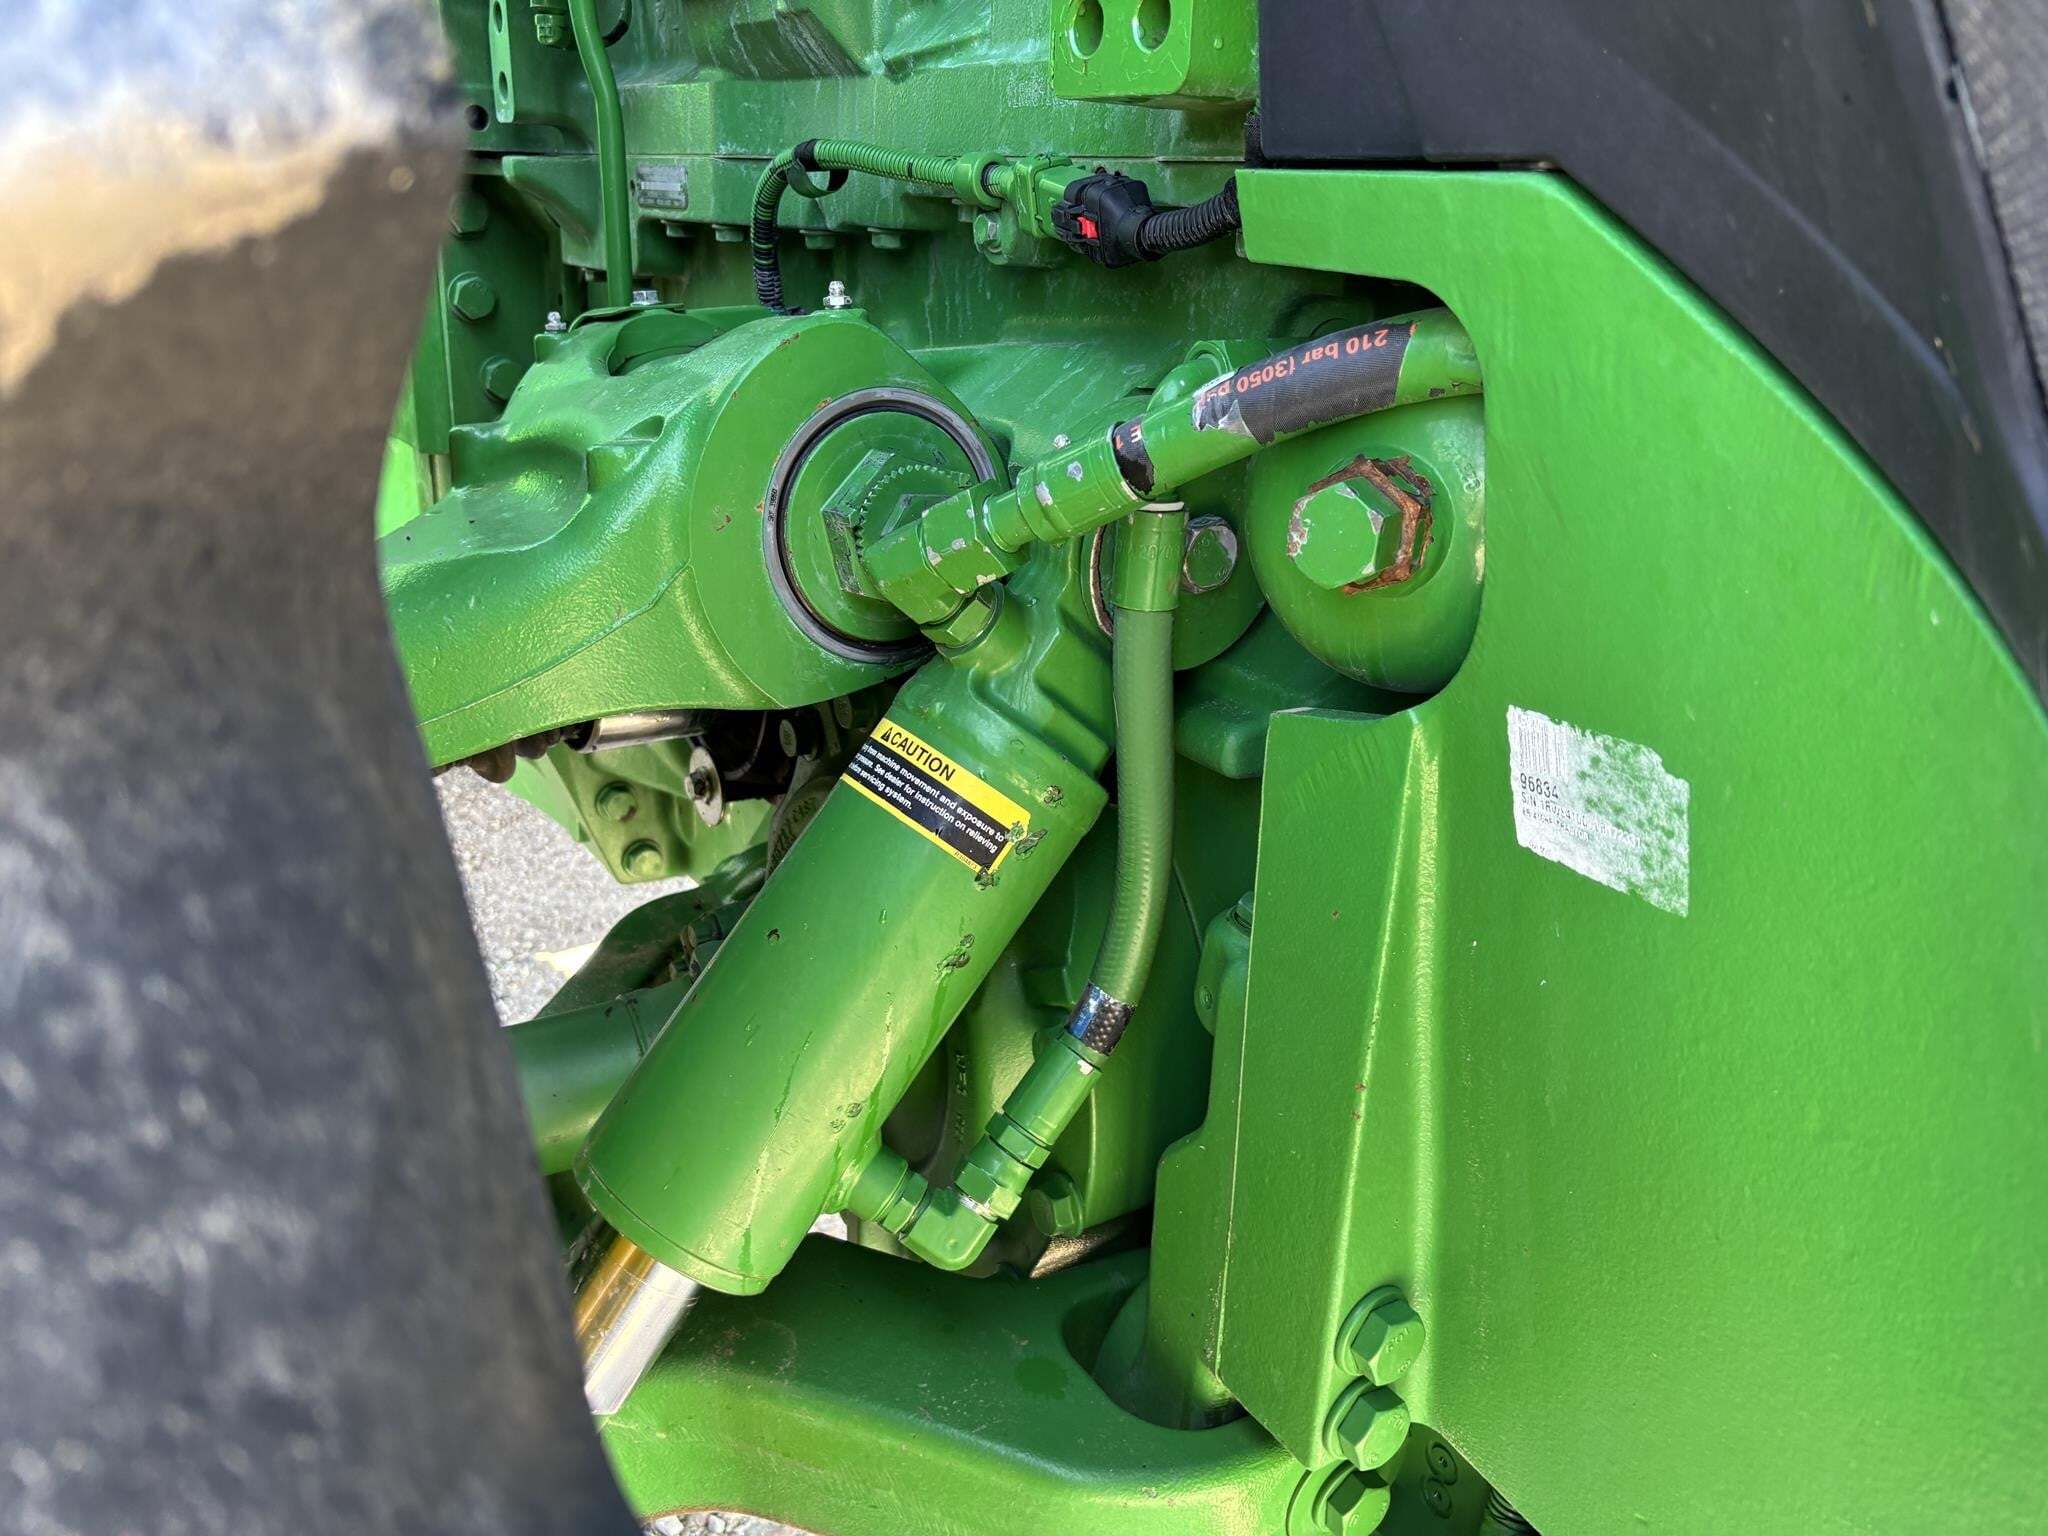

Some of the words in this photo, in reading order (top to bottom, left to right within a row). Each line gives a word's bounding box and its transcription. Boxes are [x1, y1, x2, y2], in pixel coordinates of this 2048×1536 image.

[1302, 341, 1340, 366] bar
[1346, 328, 1389, 355] 210
[1237, 356, 1296, 393] (3050
[890, 731, 956, 781] CAUTION
[860, 770, 886, 791] servicing
[884, 786, 912, 810] system.
[875, 752, 900, 771] machine
[900, 768, 941, 798] movement
[939, 794, 958, 809] and
[957, 806, 995, 835] exposure
[995, 831, 1004, 842] to
[1520, 772, 1559, 799] 96834
[874, 764, 886, 775] See
[884, 771, 905, 788] dealer
[903, 783, 916, 796] for
[914, 791, 955, 823] instruction
[954, 820, 967, 831] on
[965, 827, 998, 854] relieving
